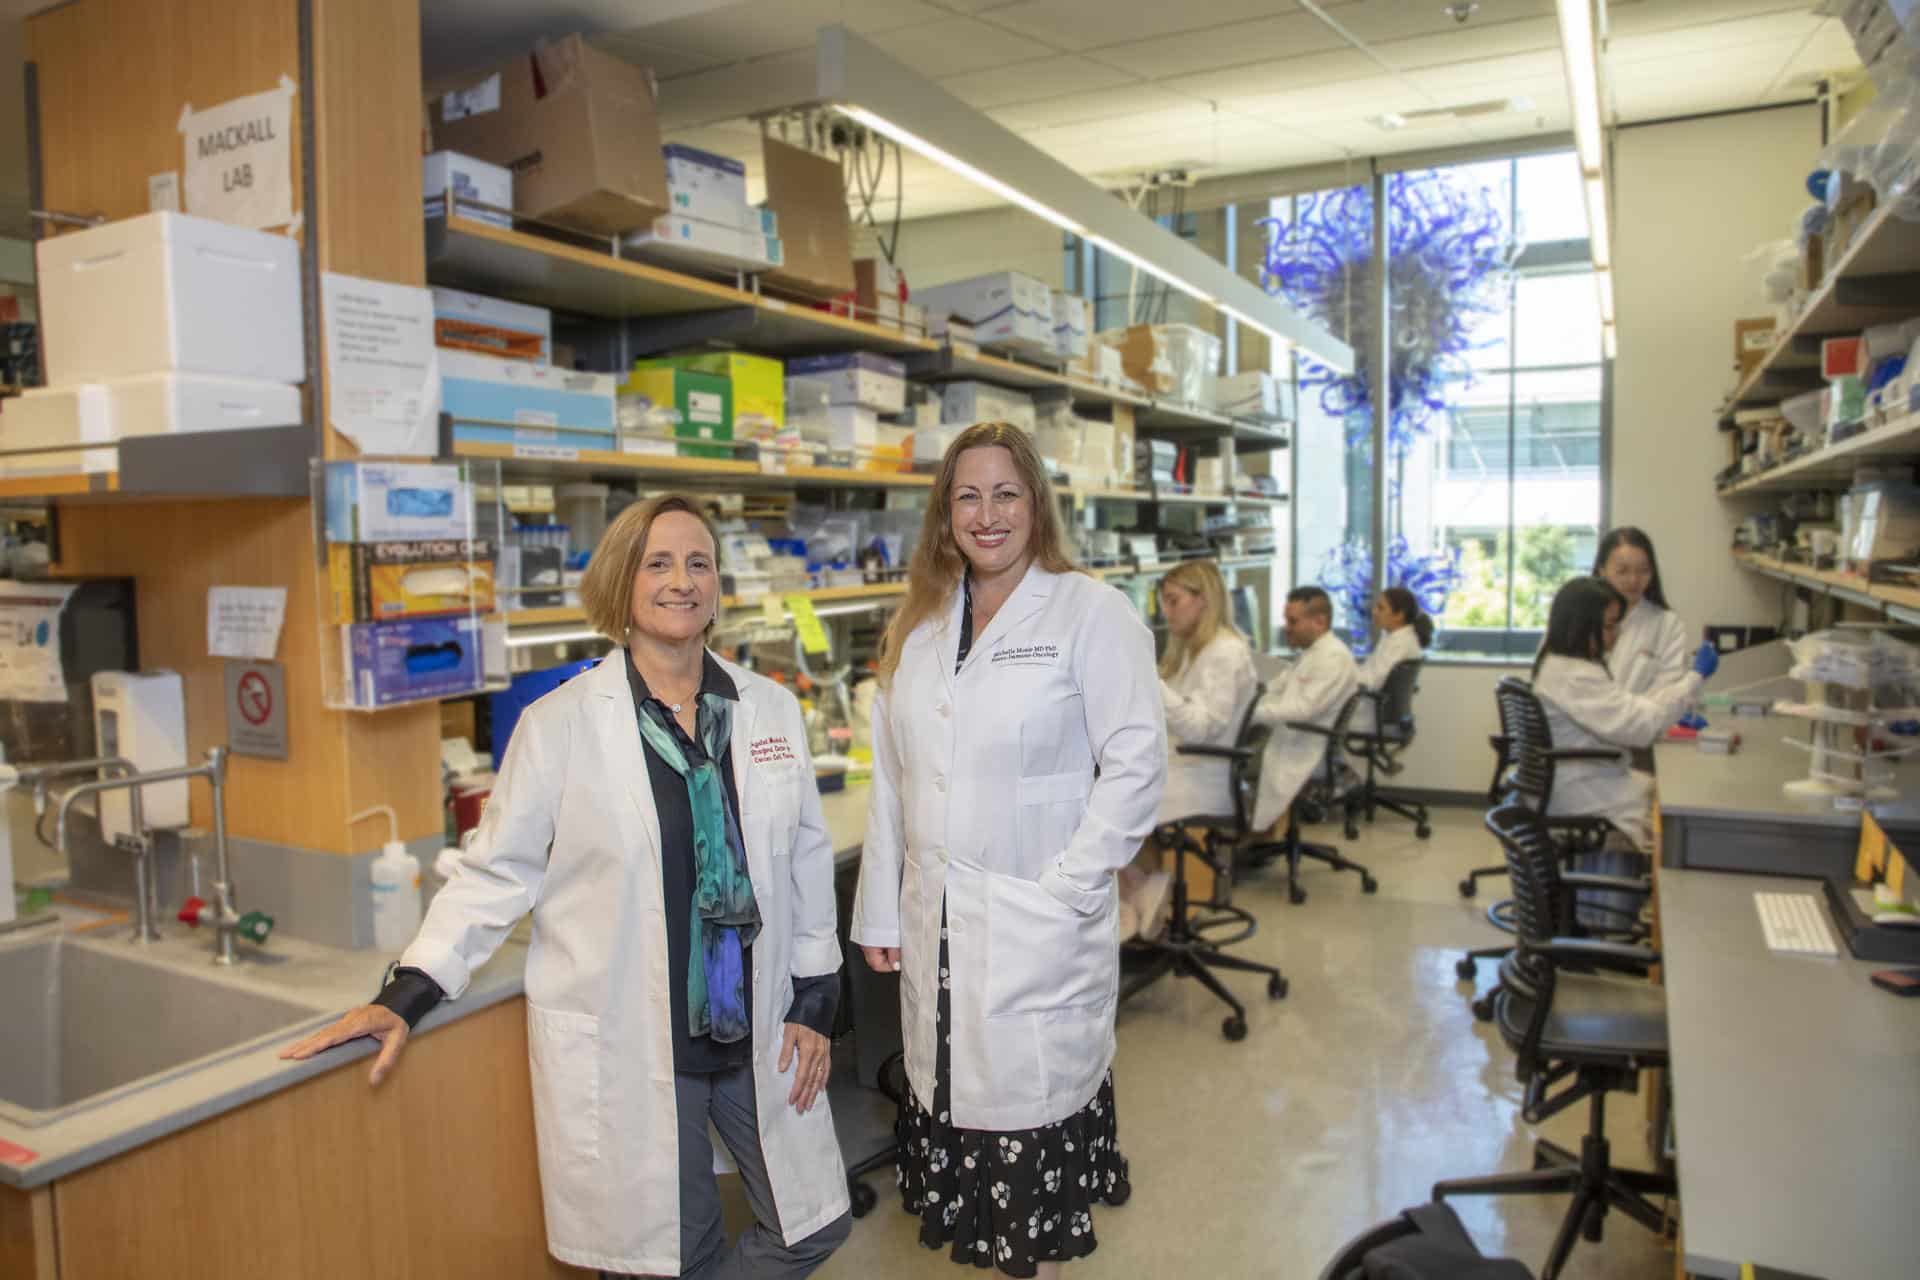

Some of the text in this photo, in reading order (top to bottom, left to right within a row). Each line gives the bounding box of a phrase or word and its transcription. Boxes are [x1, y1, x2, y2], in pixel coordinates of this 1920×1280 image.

[196, 115, 276, 158] MACKALL
[222, 162, 254, 193] LAB
[375, 541, 457, 561] EVOLUTION
